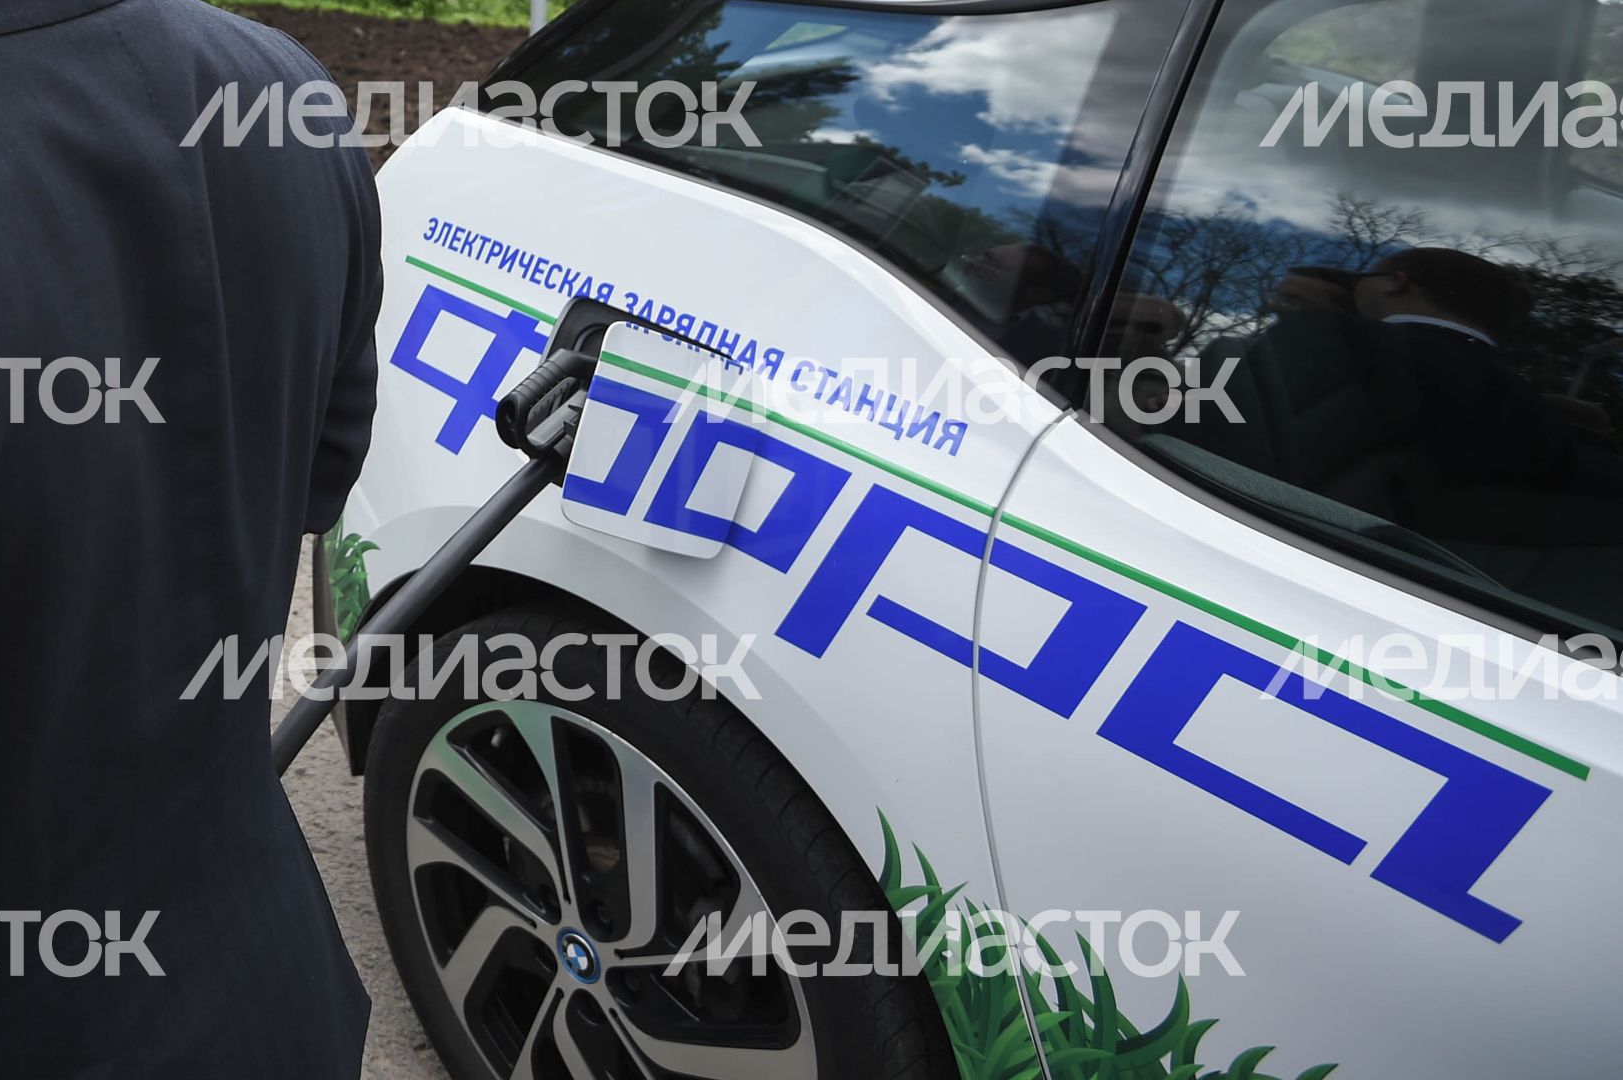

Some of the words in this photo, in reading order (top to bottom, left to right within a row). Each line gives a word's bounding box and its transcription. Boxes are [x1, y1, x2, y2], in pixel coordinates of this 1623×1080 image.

[423, 217, 615, 306] ЭЛЕКТРИЧЕСКАЯ
[624, 291, 786, 381] ЗАРЯДНАЯ
[790, 361, 968, 457] СТАНЦИЯ
